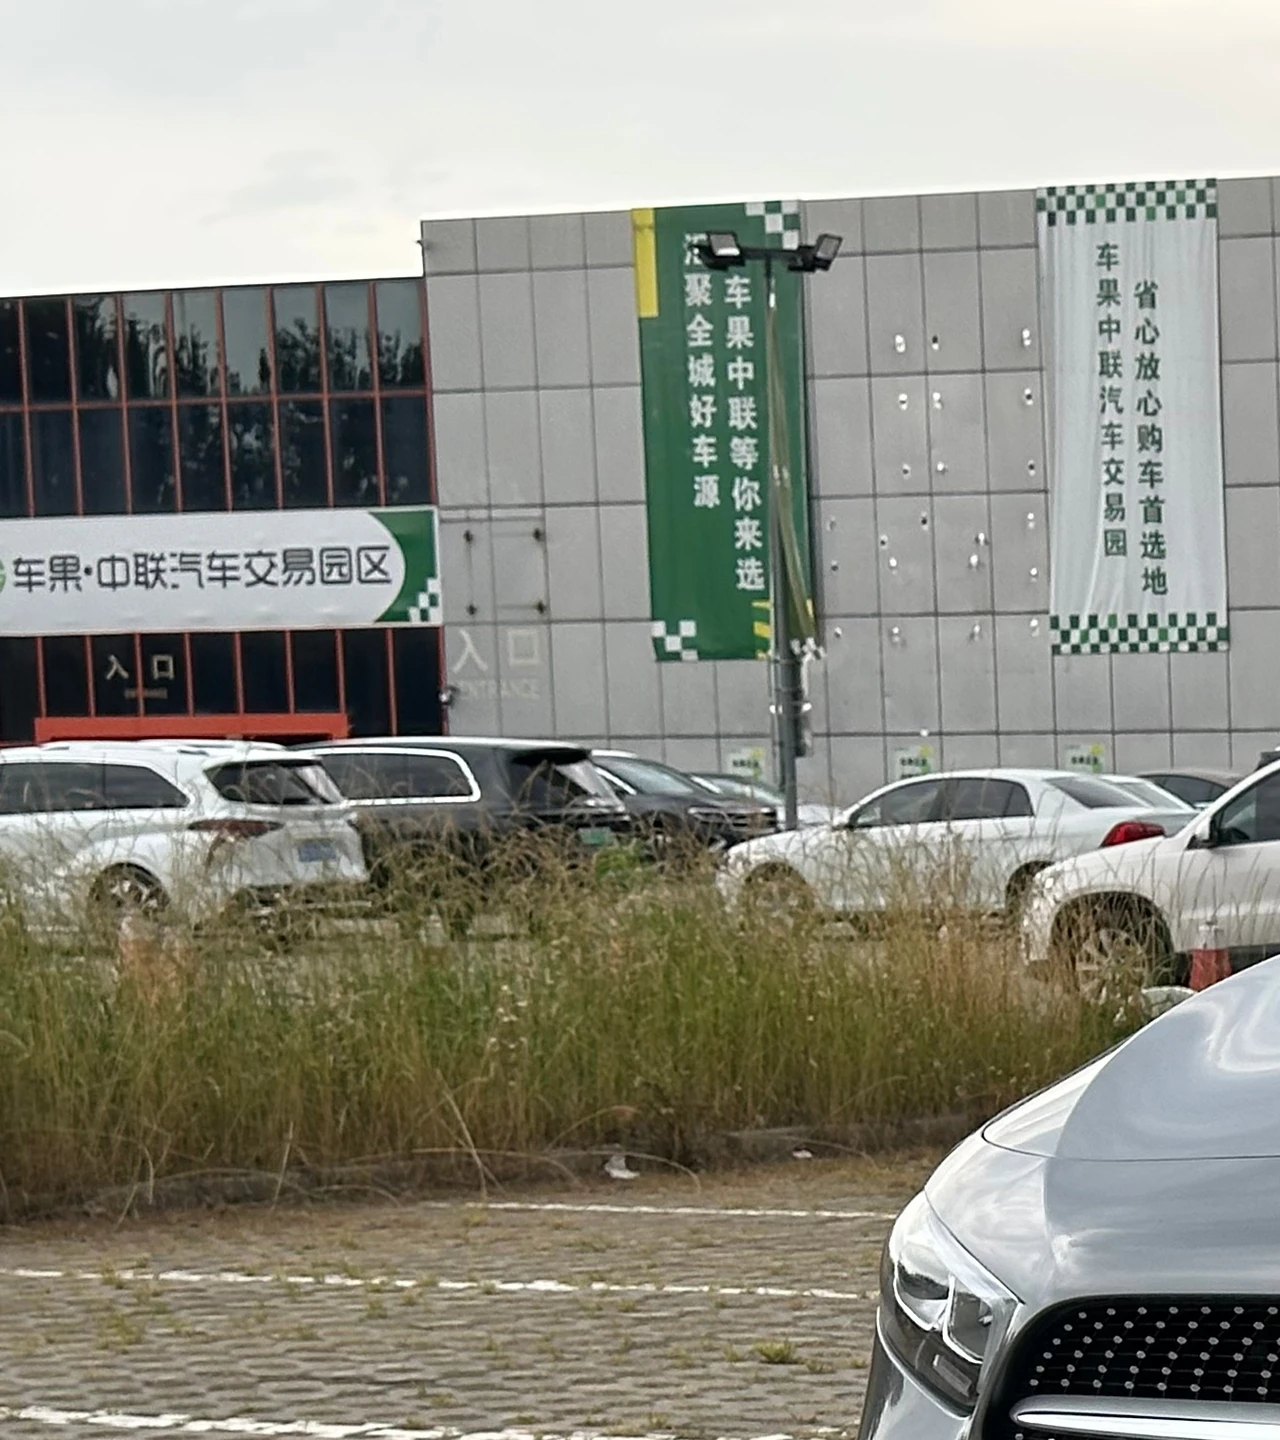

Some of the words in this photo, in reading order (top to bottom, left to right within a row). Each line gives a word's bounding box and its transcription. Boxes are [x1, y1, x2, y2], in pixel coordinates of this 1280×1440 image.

[724, 275, 766, 590] 车果中联等你来选
[1096, 242, 1127, 557] 车果中联汽车交易园
[1134, 280, 1168, 596] 省心放心购车首选地
[13, 546, 392, 593] 车果·中联汽车交易园区
[453, 628, 541, 673] 入口
[106, 654, 176, 681] 入口
